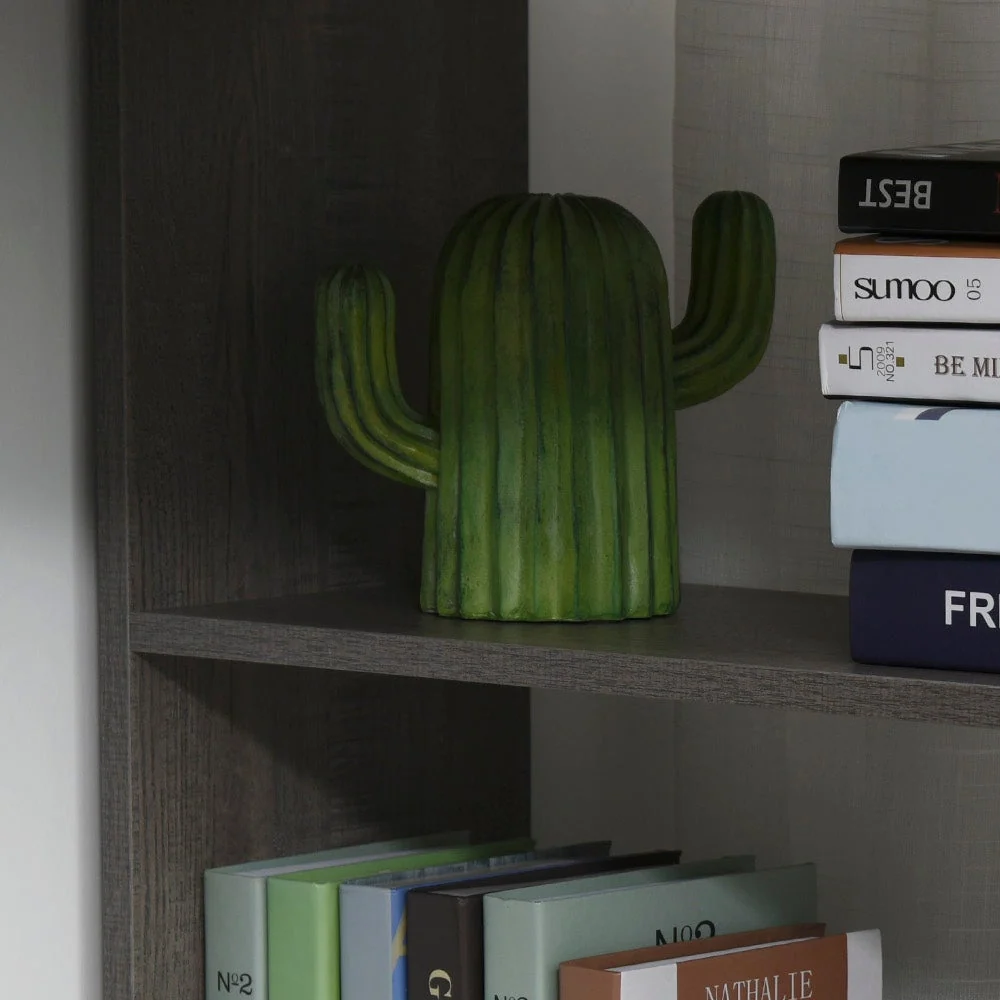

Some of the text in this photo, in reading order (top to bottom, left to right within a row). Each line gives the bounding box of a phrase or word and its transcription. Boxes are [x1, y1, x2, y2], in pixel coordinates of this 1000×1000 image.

[859, 178, 932, 210] BEST
[853, 277, 956, 302] sumoo
[933, 354, 966, 376] BE
